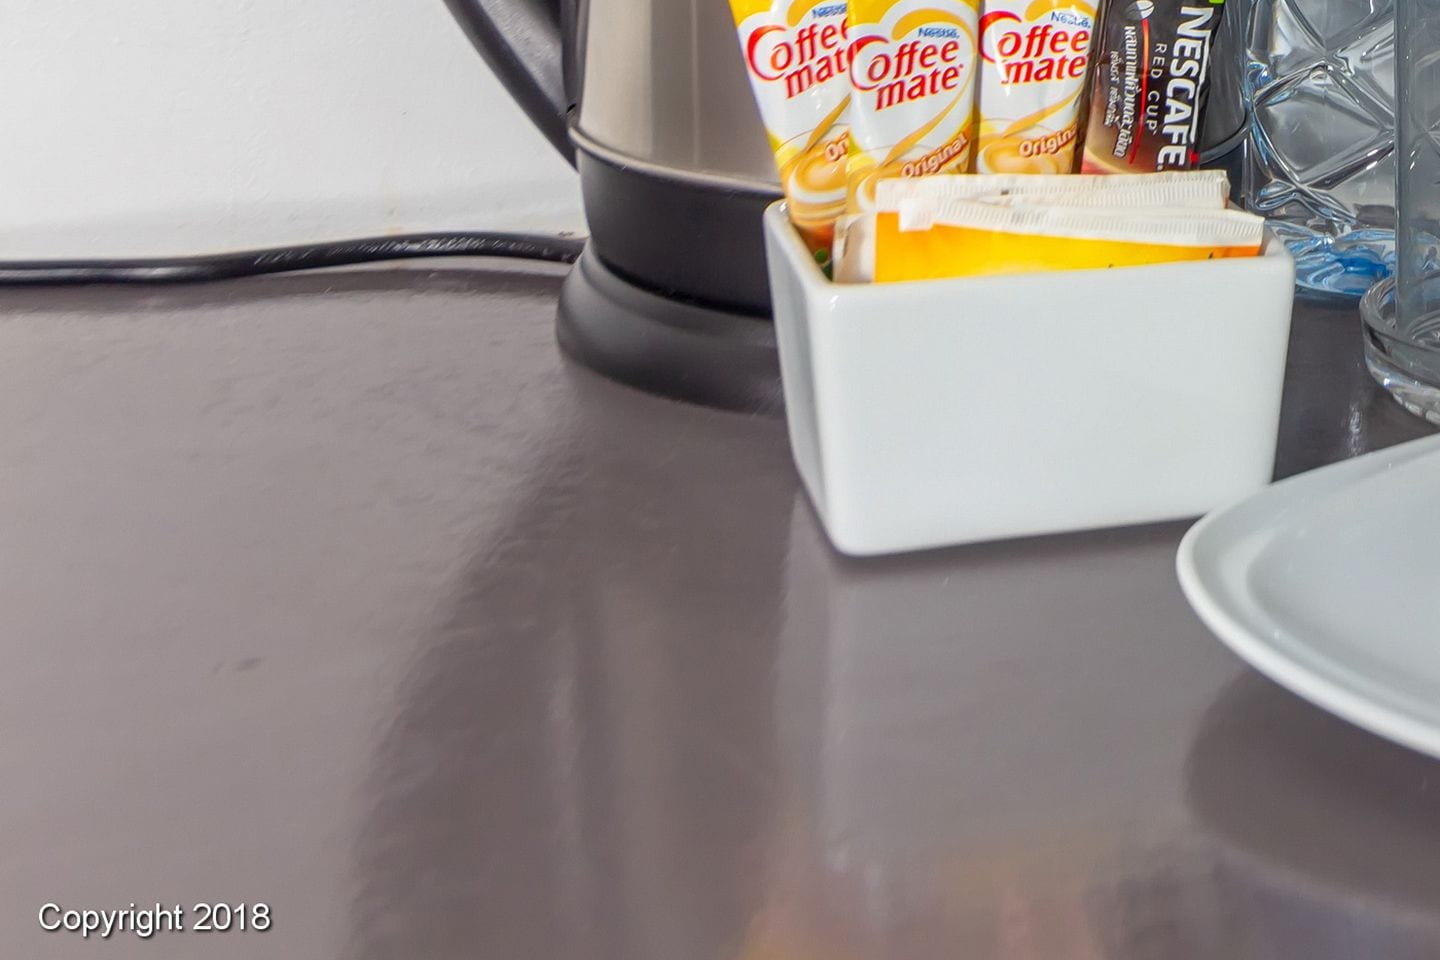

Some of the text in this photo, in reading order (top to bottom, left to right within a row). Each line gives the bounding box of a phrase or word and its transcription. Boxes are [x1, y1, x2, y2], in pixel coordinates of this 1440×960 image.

[978, 11, 1090, 63] Coffee
[785, 48, 848, 99] mat
[848, 35, 960, 91] Coffee
[875, 64, 960, 112] mate
[1001, 55, 1087, 84] mate
[1146, 43, 1168, 130] RED CUP
[901, 133, 968, 178] Original
